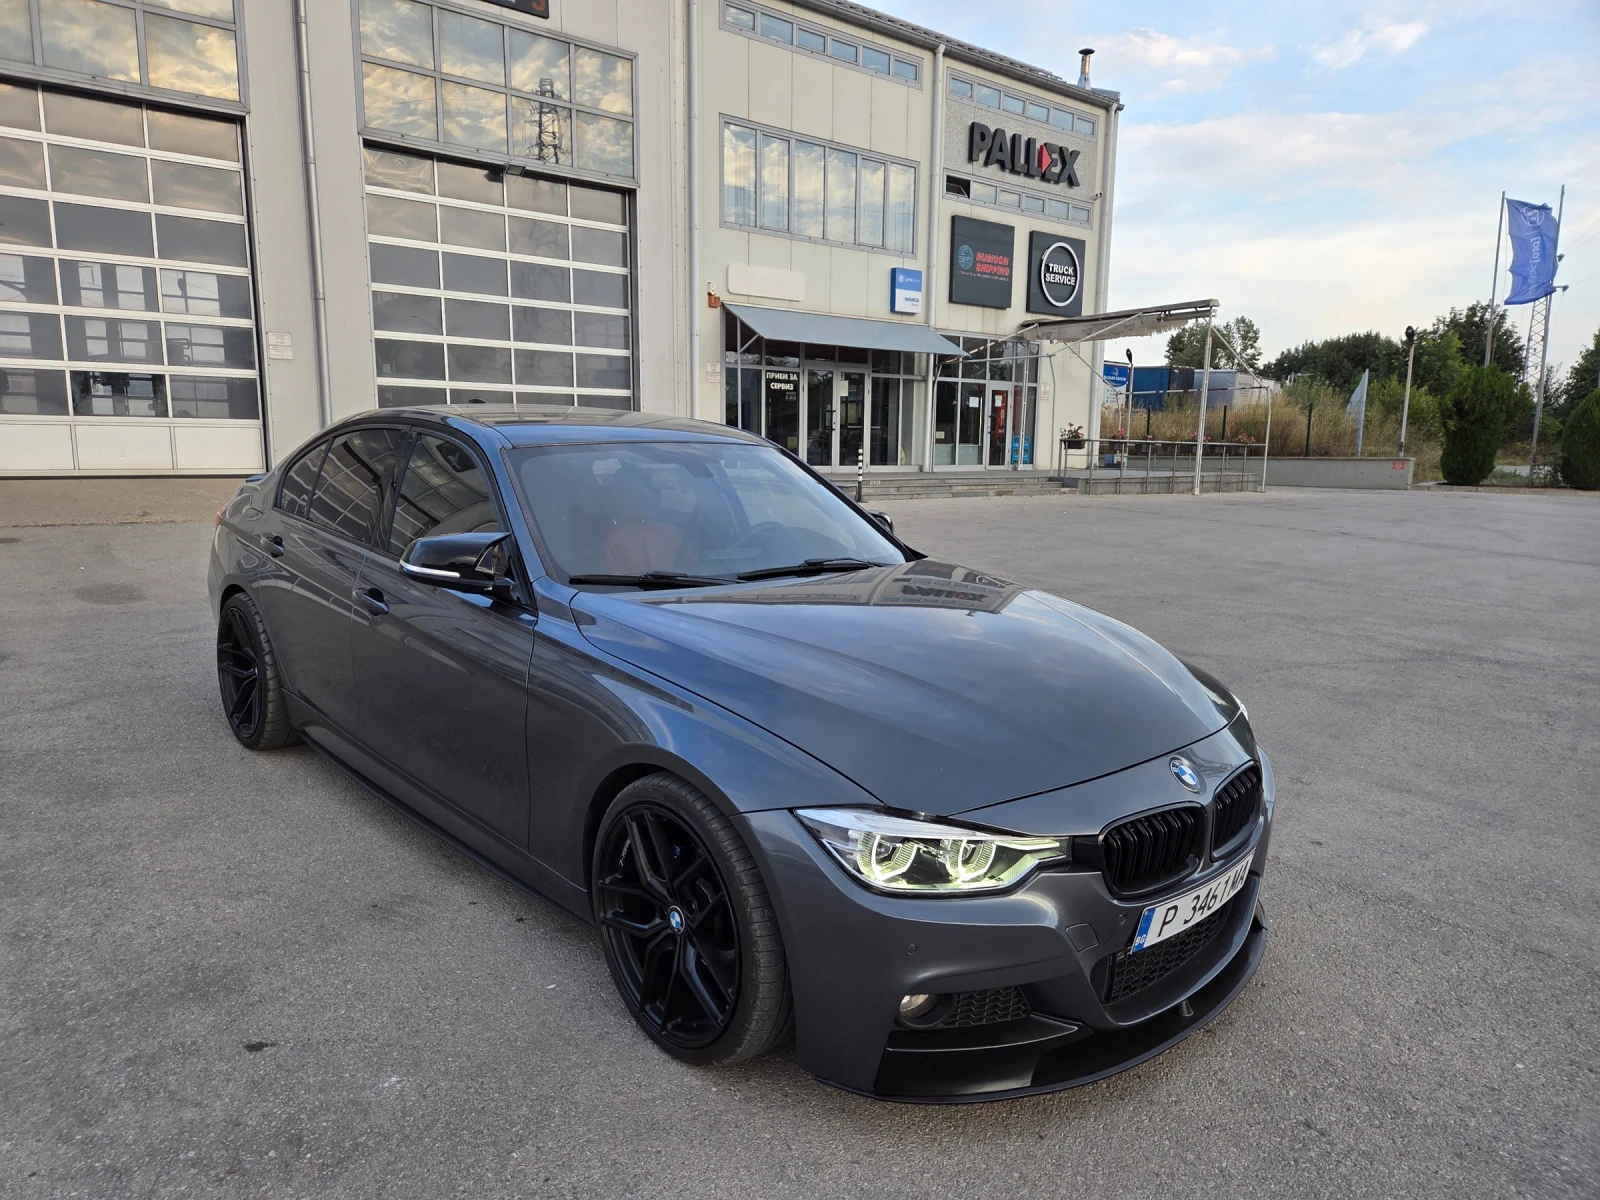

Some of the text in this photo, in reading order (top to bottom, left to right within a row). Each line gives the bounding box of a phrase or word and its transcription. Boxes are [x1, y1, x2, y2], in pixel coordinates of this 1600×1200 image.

[976, 252, 1010, 265] RUBICON
[976, 262, 1010, 276] SHIPPING
[1048, 263, 1074, 276] TRUCK
[1045, 272, 1076, 286] SERVICE
[766, 372, 798, 381] ПРИЕМ ЗА
[770, 382, 794, 391] СЕРВИЗ
[1157, 859, 1250, 938] P 3461 MA
[1135, 934, 1147, 946] BG
